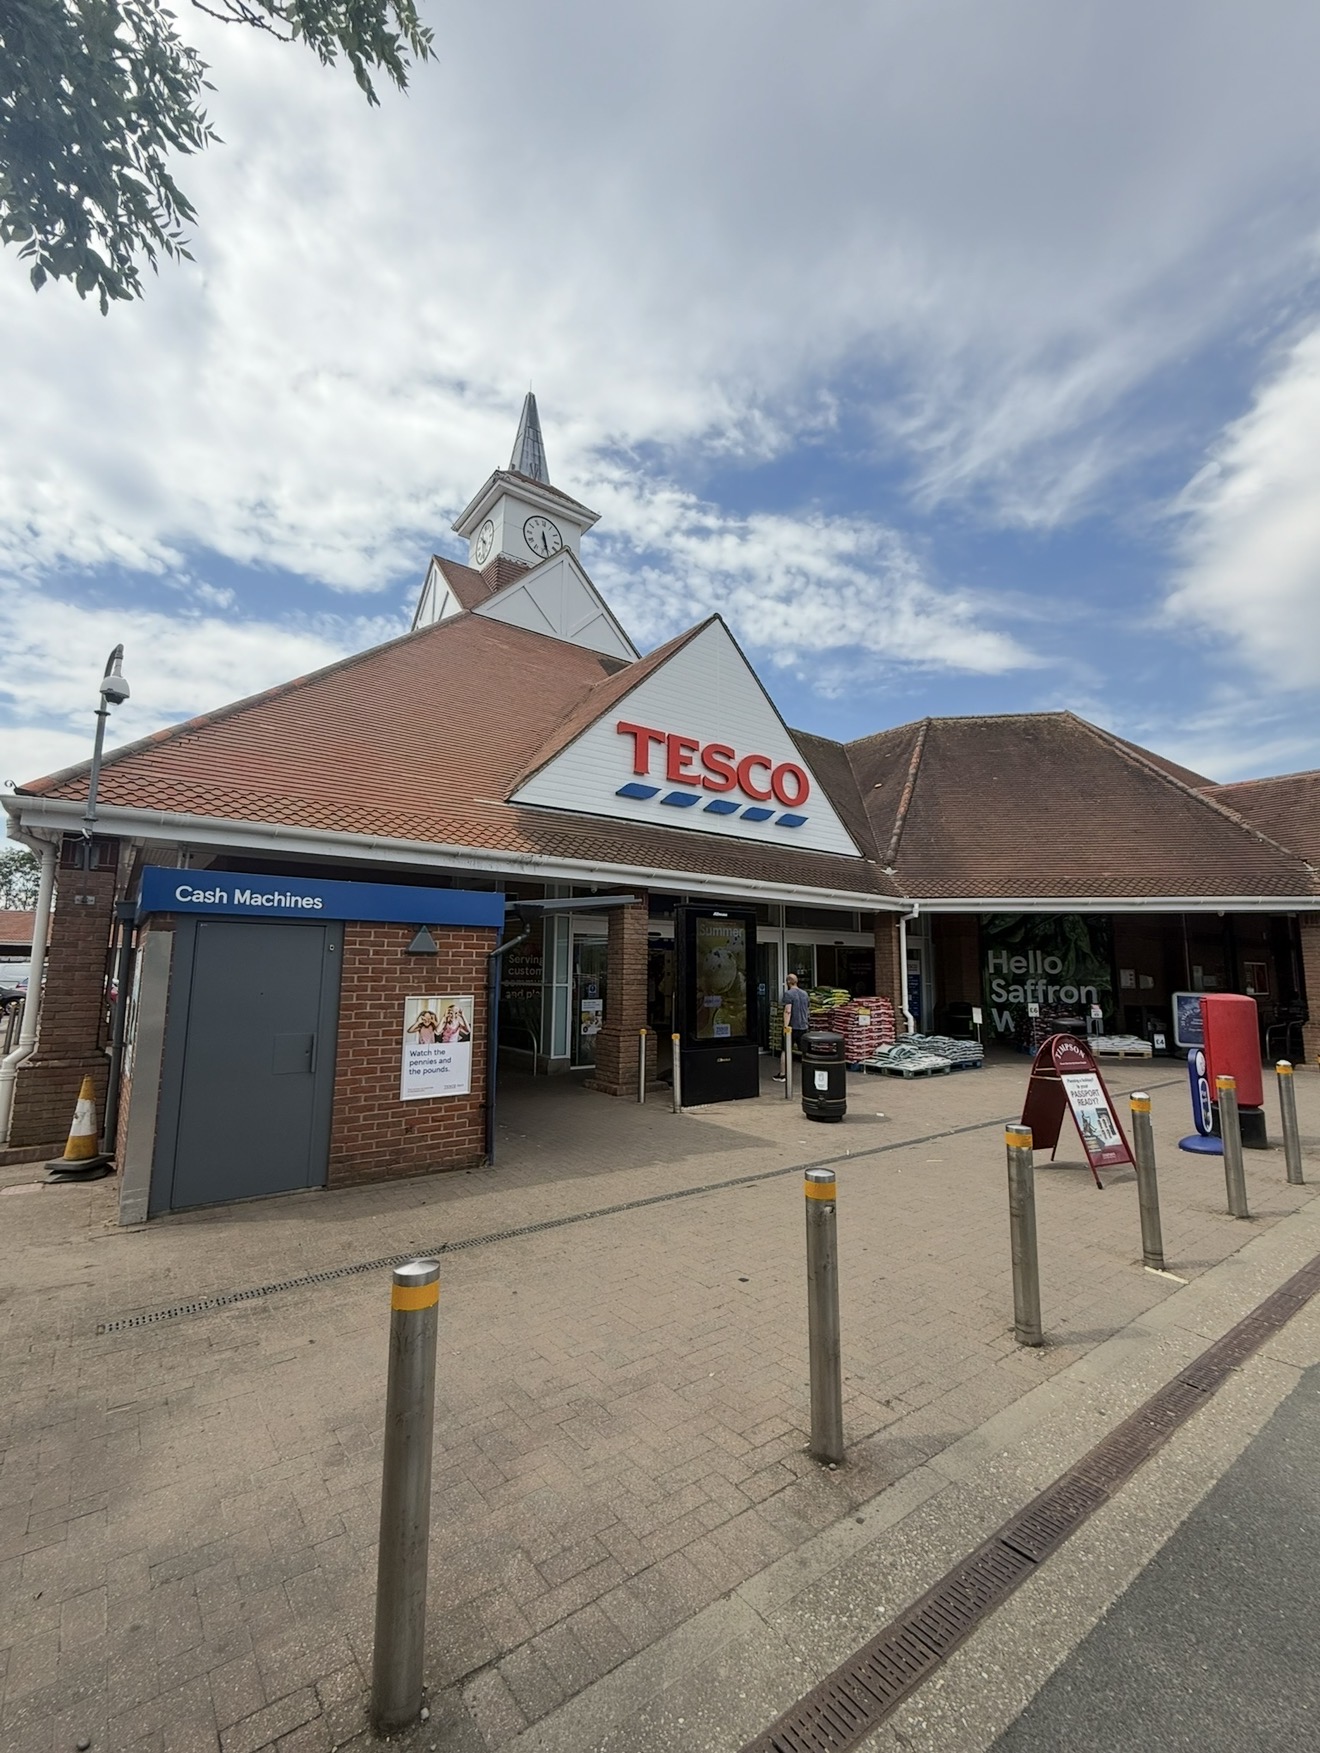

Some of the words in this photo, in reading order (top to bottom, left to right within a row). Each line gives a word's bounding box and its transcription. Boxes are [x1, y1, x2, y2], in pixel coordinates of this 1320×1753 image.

[616, 720, 810, 808] TESCO
[175, 885, 228, 904] Cash
[234, 889, 323, 910] Machines
[699, 924, 745, 938] Summer
[508, 954, 544, 967] Serving
[987, 950, 1063, 975] Hello
[508, 967, 543, 976] custom
[990, 979, 1098, 1004] Saffron
[409, 1049, 432, 1057] Watch
[1055, 1043, 1085, 1059] TIMPSON
[409, 1058, 437, 1067] pennies
[438, 1057, 452, 1065] and
[423, 1066, 451, 1076] pounds.
[1070, 1089, 1099, 1098] PASSPORT
[1077, 1097, 1099, 1106] READY?
